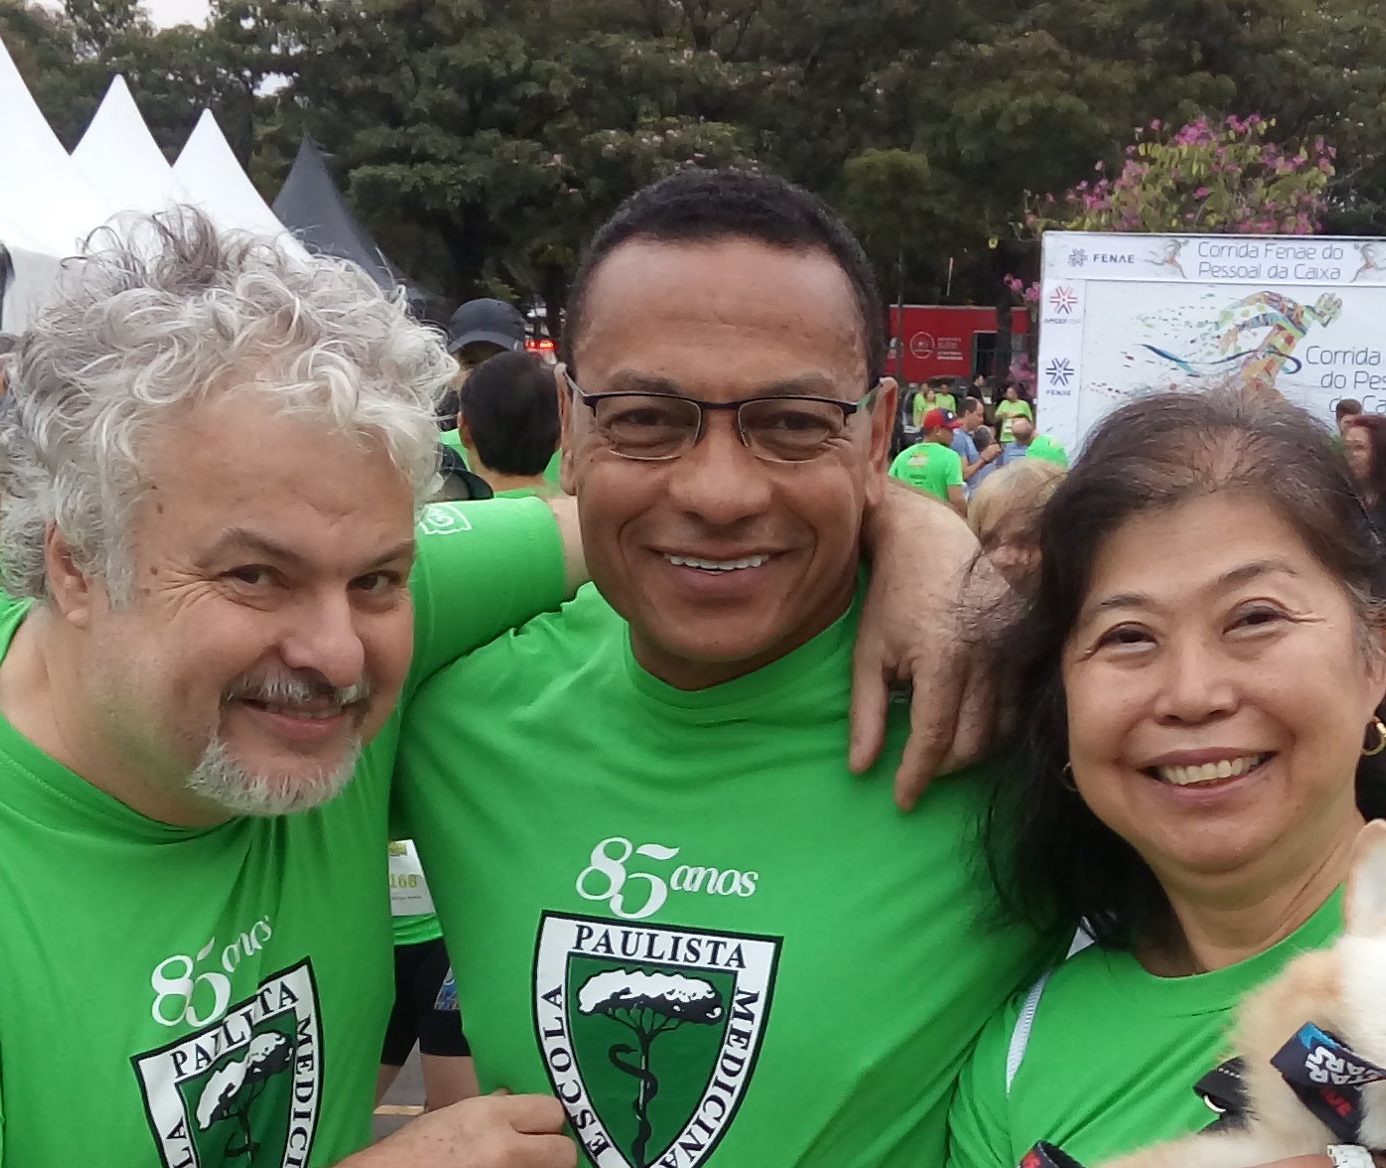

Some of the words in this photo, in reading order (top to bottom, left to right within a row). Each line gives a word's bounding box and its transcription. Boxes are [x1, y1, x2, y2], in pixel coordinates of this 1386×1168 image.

[1092, 254, 1135, 265] FENAE
[1198, 241, 1259, 259] Corrida
[1264, 243, 1315, 259] Fenae
[1321, 243, 1344, 260] do
[1198, 261, 1262, 279] Pessoal
[1267, 263, 1288, 280] da
[1293, 263, 1342, 280] Caixa
[1305, 345, 1381, 366] Corrida
[1320, 371, 1347, 389] do
[575, 836, 680, 920] 85
[669, 863, 759, 898] anos
[572, 924, 747, 970] PAULISTA
[540, 984, 612, 1161] ESCOLA
